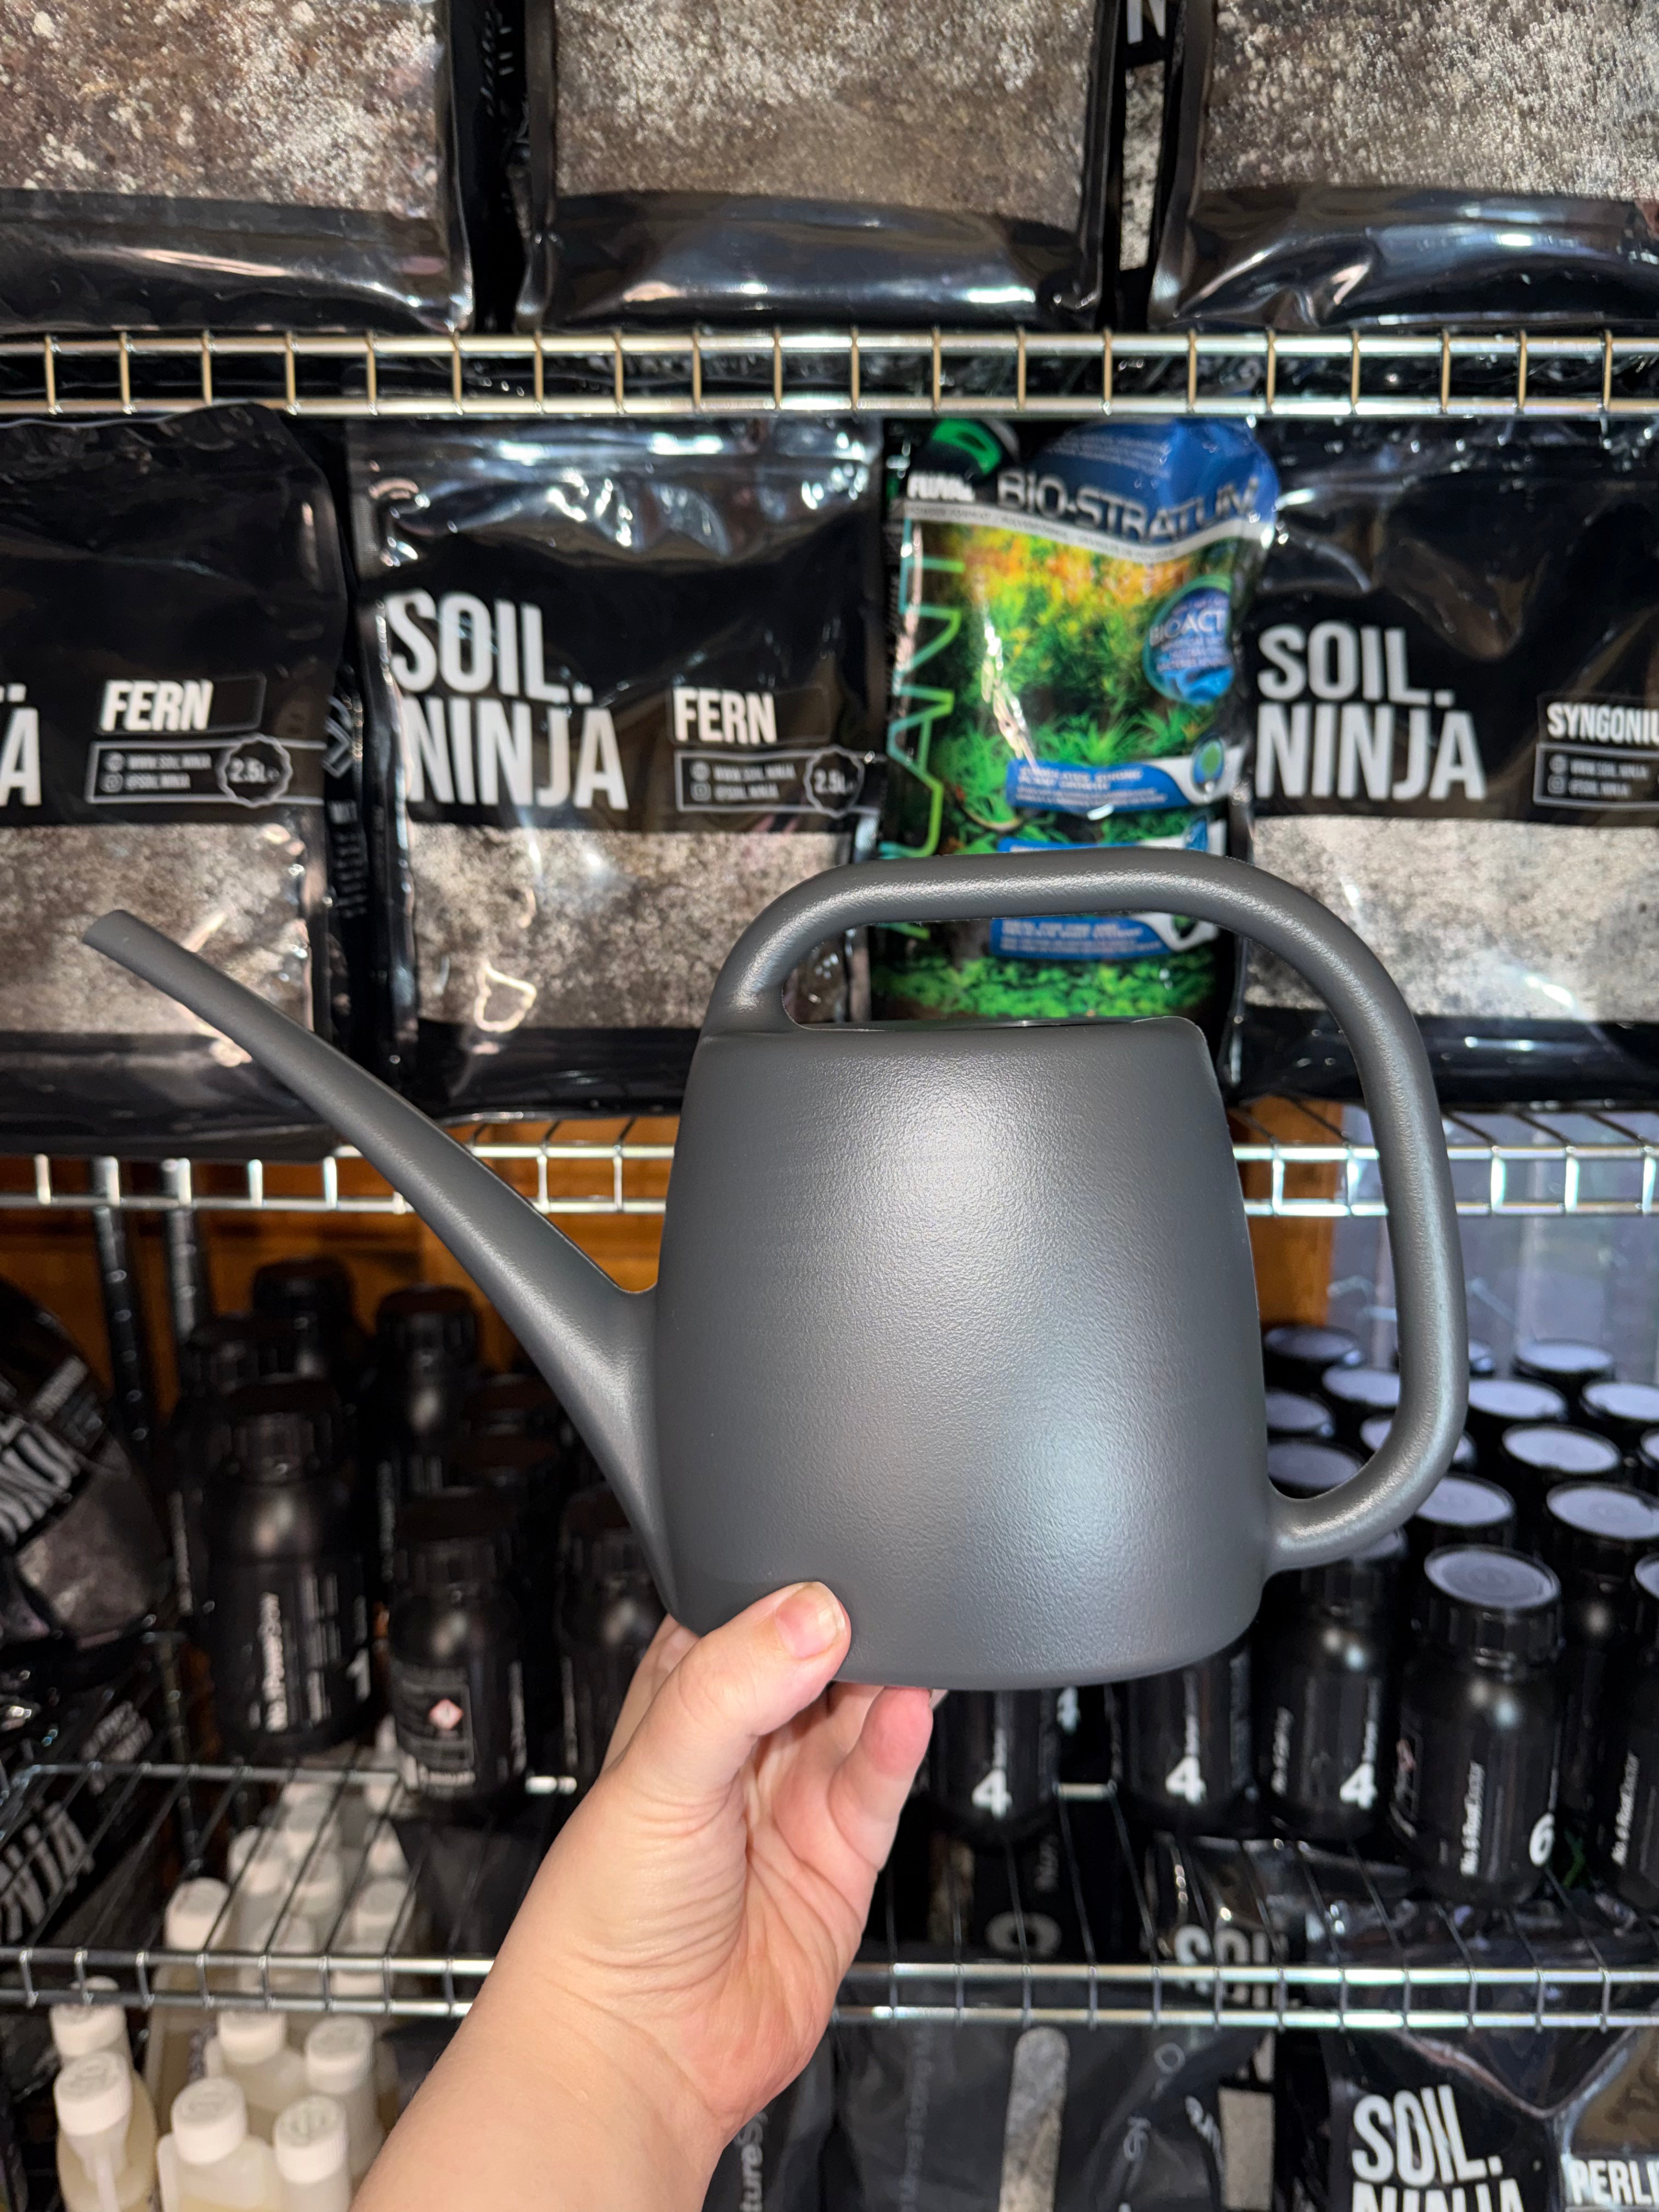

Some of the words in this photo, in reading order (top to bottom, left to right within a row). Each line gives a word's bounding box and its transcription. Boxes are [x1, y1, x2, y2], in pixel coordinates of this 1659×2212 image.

[1257, 620, 1455, 707] SOIL.
[99, 679, 214, 732] FERN
[673, 687, 777, 744] FERN
[402, 697, 629, 811] NINJA
[1255, 703, 1486, 801] NINJA
[972, 1767, 1012, 1820] 4
[1165, 1755, 1207, 1805] 4
[1339, 1762, 1378, 1810] 4
[1529, 1813, 1556, 1867] 6
[1352, 2085, 1504, 2186] SOIL.
[1568, 2159, 1659, 2205] PERLI
